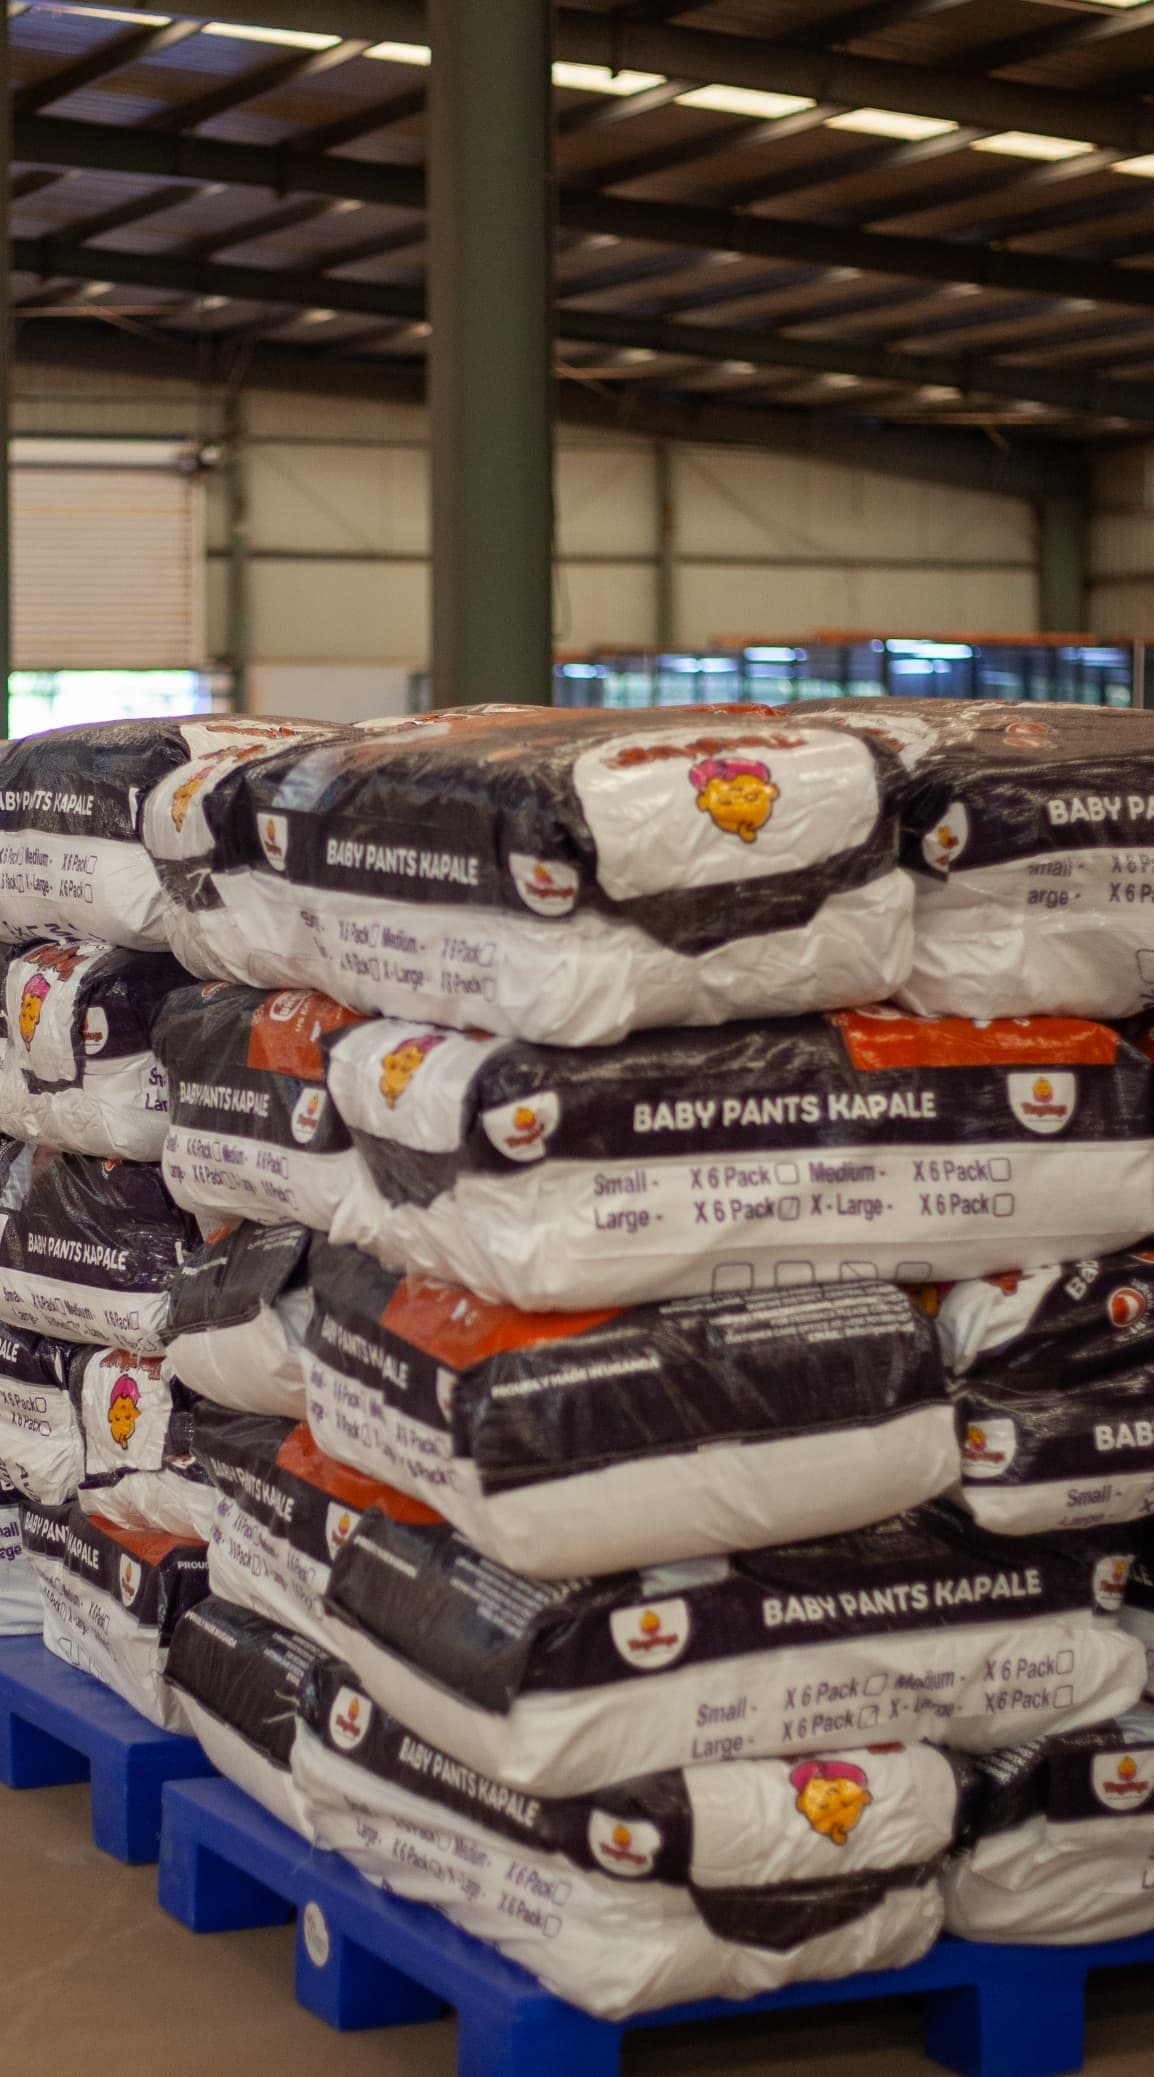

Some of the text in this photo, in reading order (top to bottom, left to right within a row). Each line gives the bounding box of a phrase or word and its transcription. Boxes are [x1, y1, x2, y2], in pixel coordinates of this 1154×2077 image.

[53, 792, 95, 815] KAPALE
[1048, 796, 1121, 825] BABY
[327, 838, 480, 886] BABY PANTS KAPALE
[1110, 882, 1121, 902] X
[1126, 884, 1135, 902] 6
[633, 1091, 938, 1133] BABY PANTS KAPALE
[593, 1160, 989, 1197] Small X 6 Pack Medium X 6 Pack
[594, 1206, 650, 1234] Large
[694, 1201, 708, 1224] X
[713, 1200, 725, 1223] 6
[730, 1197, 776, 1221] Pack
[836, 1194, 883, 1221] Large
[920, 1194, 932, 1216] X
[936, 1193, 947, 1216] 6
[951, 1193, 991, 1216] Pack
[28, 1232, 129, 1271] BABY PANTS KAPALE
[24, 1511, 44, 1536] BABY
[68, 1533, 99, 1570] KAPALE
[762, 1568, 1042, 1627] BABY PANTS KAPALE
[697, 1697, 748, 1727] Small
[785, 1687, 797, 1711] X
[801, 1684, 812, 1707] 6
[816, 1677, 858, 1704] Pack
[894, 1670, 956, 1692] Medium
[984, 1659, 996, 1682] X
[1001, 1659, 1011, 1681] 6
[1016, 1656, 1056, 1681] Pack
[692, 1736, 744, 1763] Large
[783, 1721, 794, 1743] X
[797, 1717, 809, 1739] 6
[812, 1710, 855, 1735] Pack
[985, 1692, 997, 1714] X
[995, 1691, 1006, 1712] 6
[1010, 1689, 1051, 1712] Pack
[400, 1735, 433, 1775] BABY
[433, 1753, 477, 1797] PANTS
[477, 1777, 540, 1829] KAPALE
